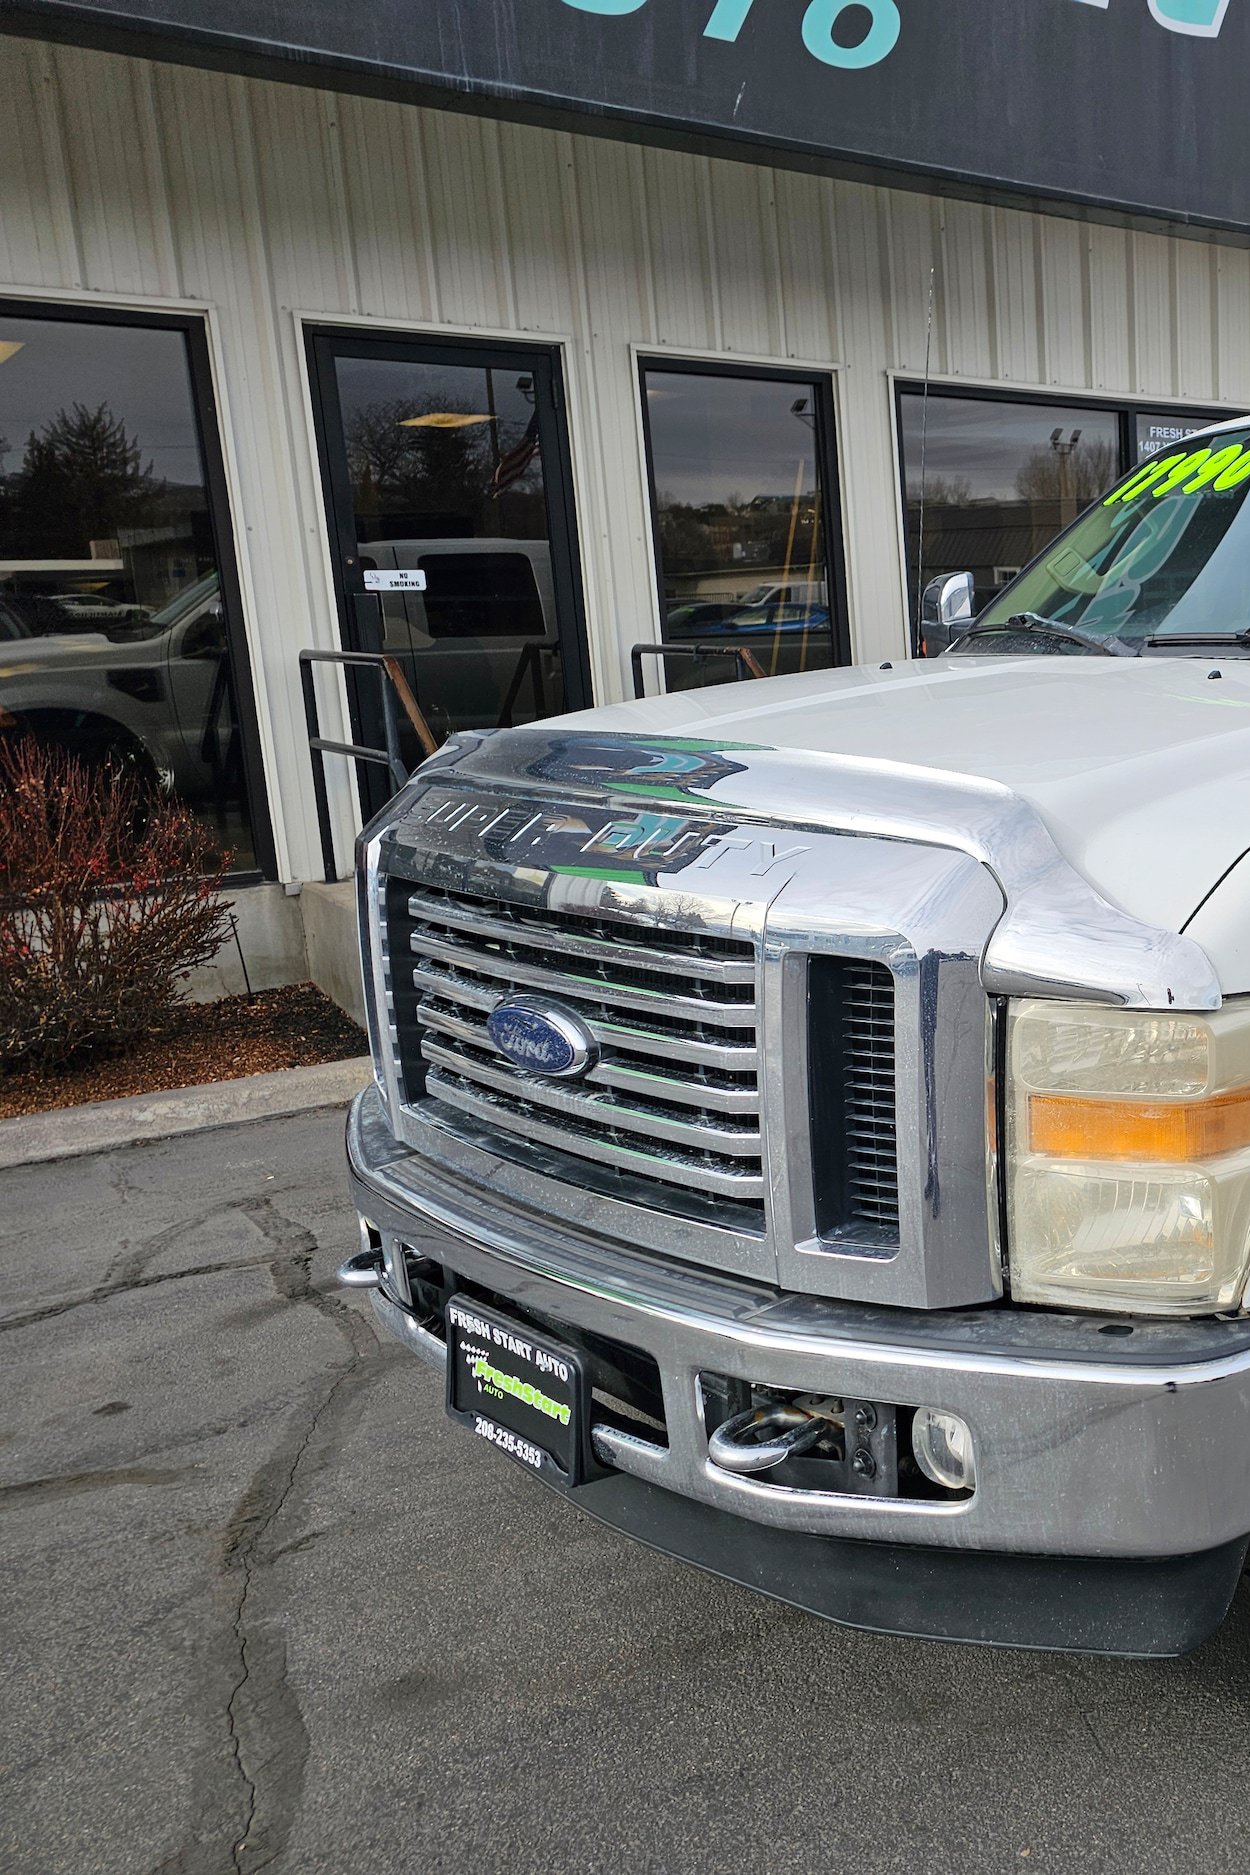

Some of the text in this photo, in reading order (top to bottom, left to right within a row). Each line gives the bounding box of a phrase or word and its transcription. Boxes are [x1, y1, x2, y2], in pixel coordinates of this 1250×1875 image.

[1138, 441, 1160, 452] 1407
[1150, 426, 1184, 439] FRESH
[578, 821, 812, 877] DUTY
[449, 1307, 569, 1382] FRESH START AUTO
[475, 1359, 572, 1426] FreshStart
[483, 1383, 504, 1400] AUTO
[474, 1416, 542, 1469] 208-235-5353
